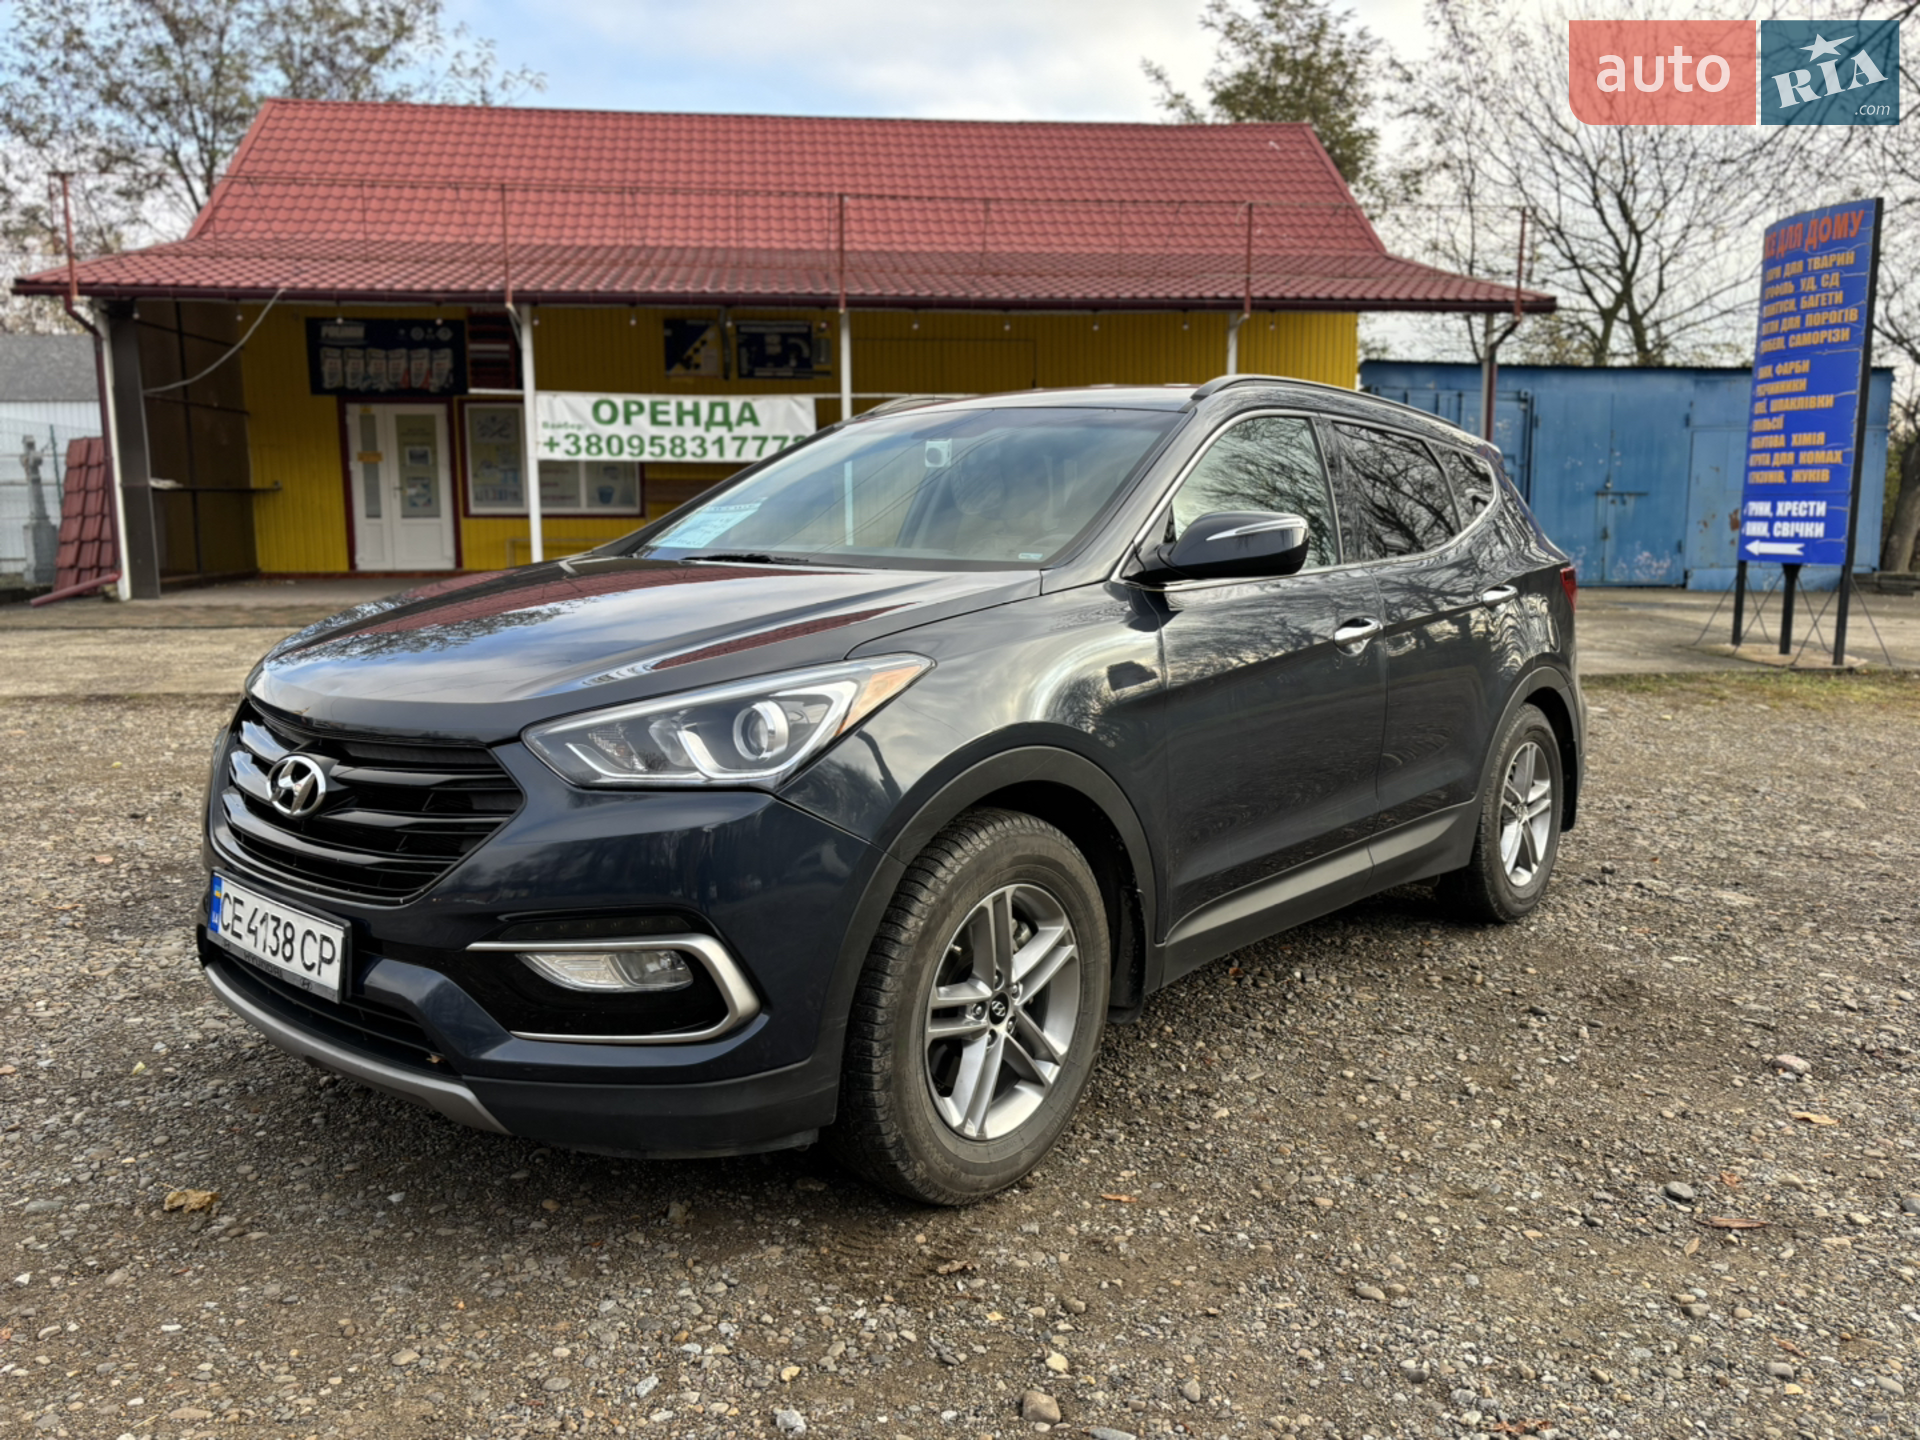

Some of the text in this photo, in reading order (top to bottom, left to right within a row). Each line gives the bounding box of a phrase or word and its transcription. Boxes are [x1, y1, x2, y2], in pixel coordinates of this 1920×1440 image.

[1776, 222, 1803, 259] ДЛЯ
[1805, 209, 1864, 251] ДОМУ
[1807, 251, 1855, 271] ТВАРИН
[1800, 290, 1843, 309] БАГЕТИ
[1805, 308, 1858, 328] ПОРОГІВ
[1788, 328, 1850, 348] САМОРІЗИ
[1775, 359, 1811, 376] ФАРБИ
[1770, 394, 1834, 413] ШПАКЛІВКИ
[591, 398, 761, 432] ОРЕНДА
[1791, 431, 1826, 447] ХІМІЯ
[1772, 452, 1795, 467] ДЛЯ
[1799, 450, 1843, 464] КОМАХ
[1791, 469, 1830, 483] ЖУКІВ
[1776, 501, 1827, 517] ХРЕСТИ
[1772, 521, 1825, 538] СВІЧКИ
[221, 892, 336, 976] CE 4138 CP
